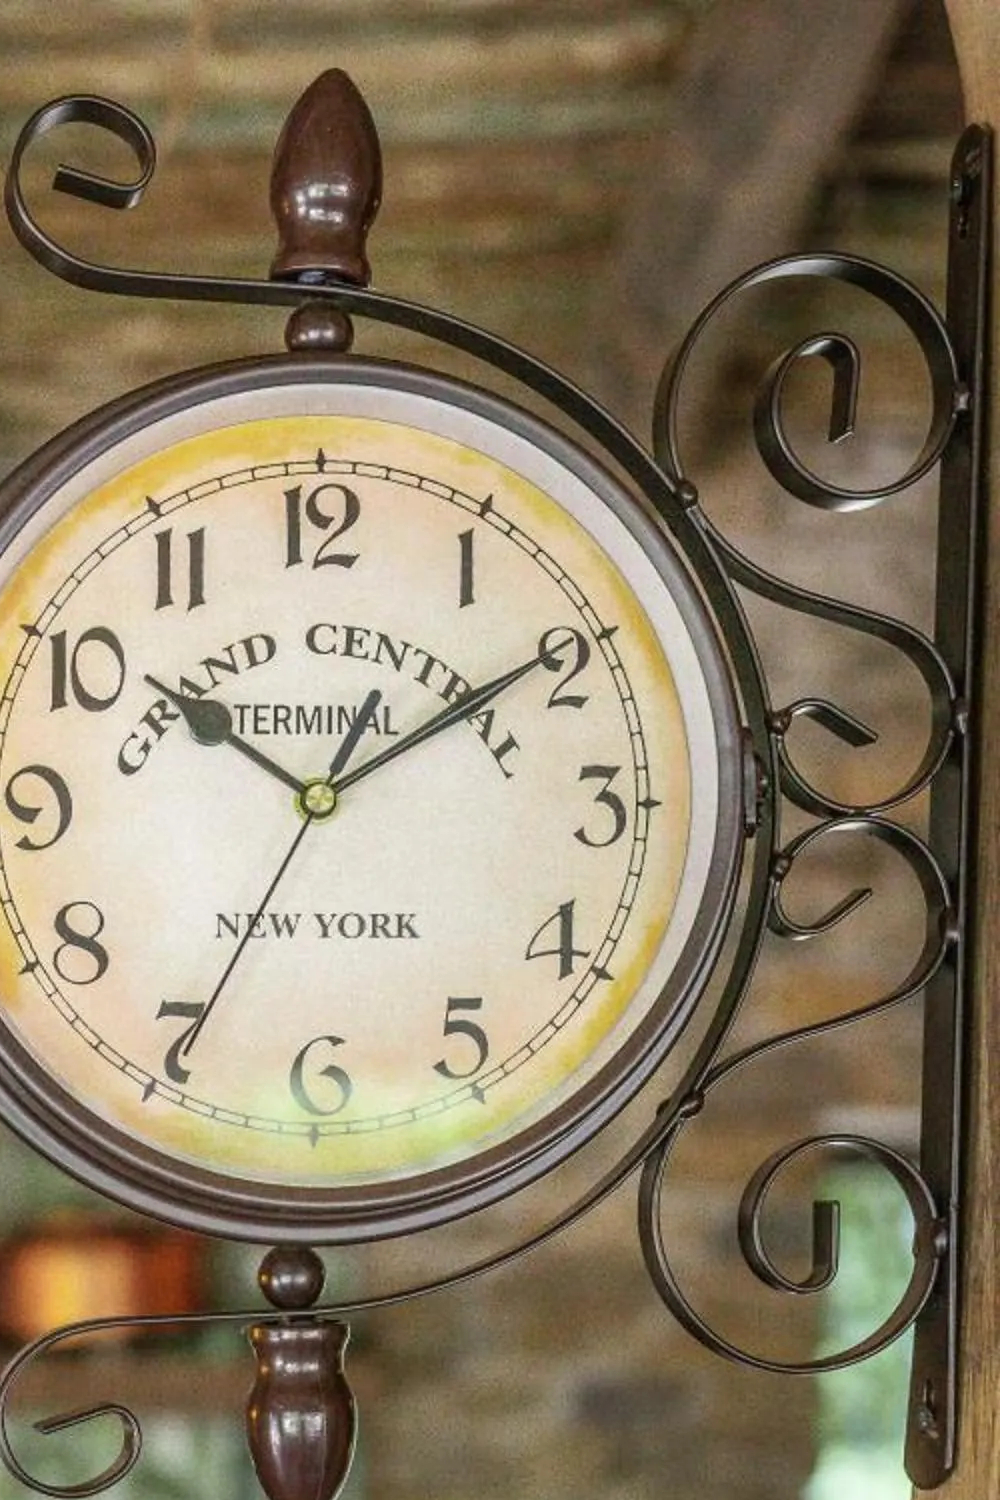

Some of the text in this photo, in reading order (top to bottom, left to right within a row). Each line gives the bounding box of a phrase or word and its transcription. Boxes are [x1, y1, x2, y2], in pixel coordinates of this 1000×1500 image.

[283, 483, 362, 570] 12
[458, 528, 475, 607] 1
[154, 526, 206, 612] 11
[49, 626, 126, 713] 10
[117, 623, 520, 779] GRAND CENTRAL
[537, 626, 591, 710] 2
[233, 703, 400, 736] TERMINAL
[4, 764, 73, 851] 9
[573, 764, 628, 848] 3
[53, 901, 110, 986] 8
[214, 912, 420, 940] NEW YORK
[525, 898, 592, 981] 4
[156, 1000, 206, 1085] 7
[289, 1035, 353, 1117] 6
[432, 996, 490, 1080] 5
